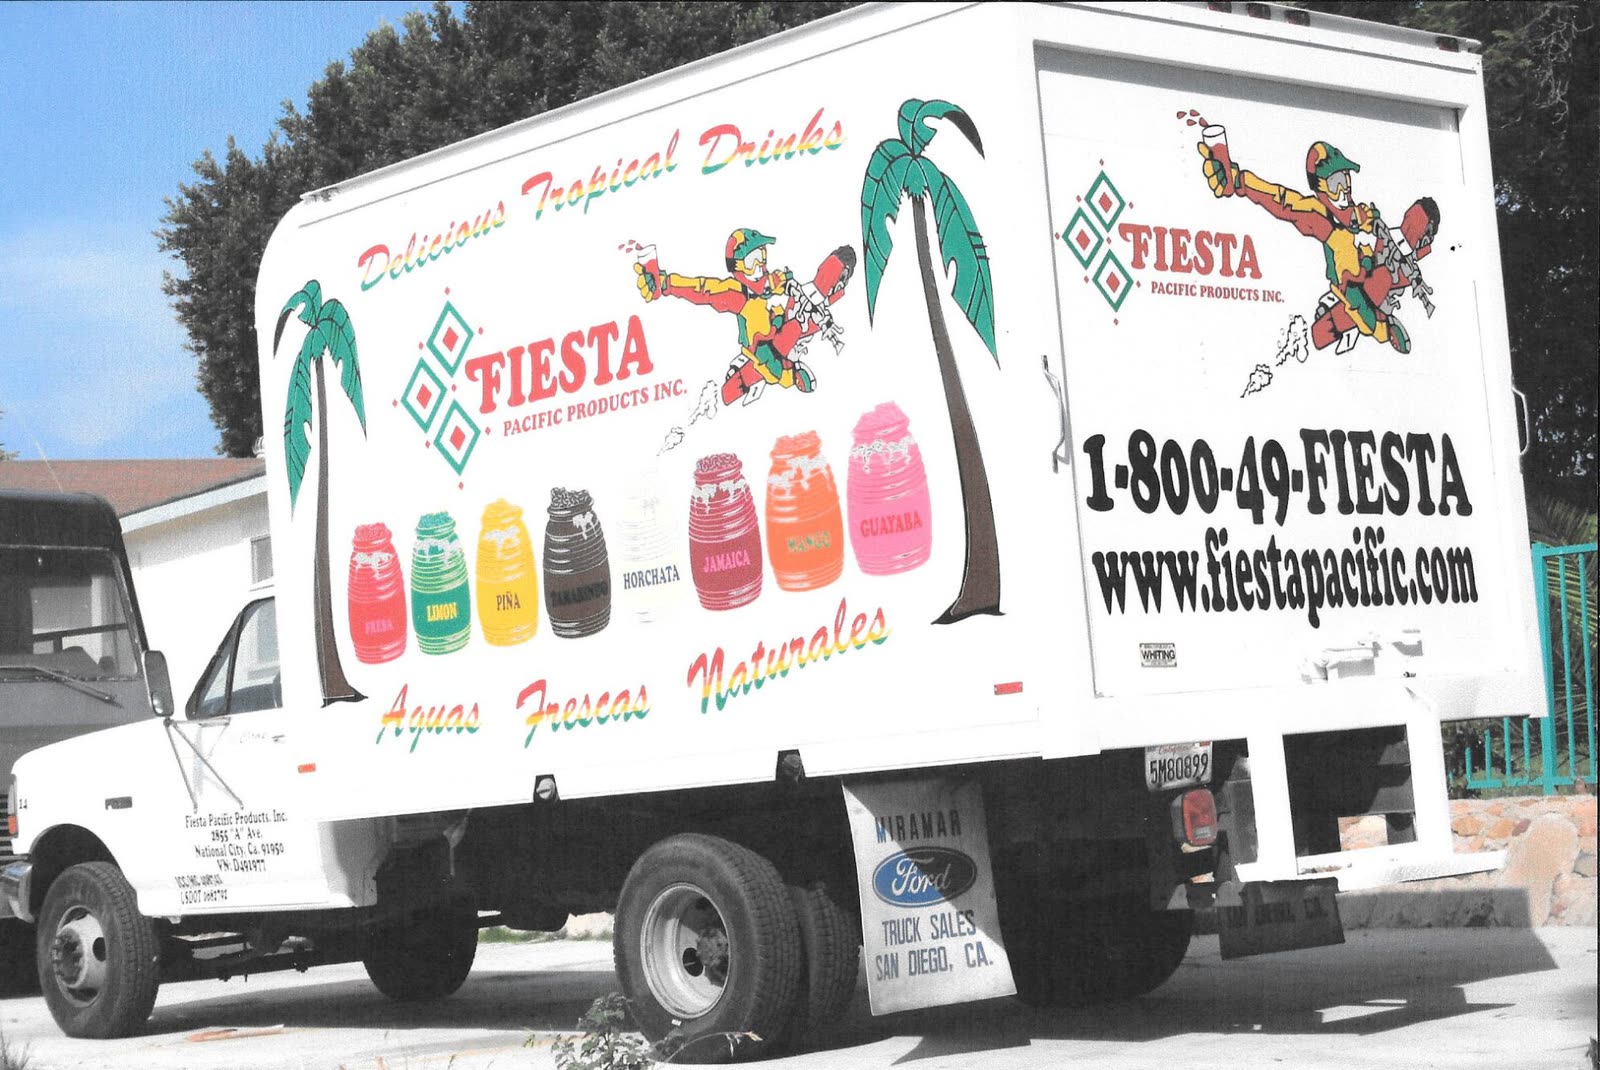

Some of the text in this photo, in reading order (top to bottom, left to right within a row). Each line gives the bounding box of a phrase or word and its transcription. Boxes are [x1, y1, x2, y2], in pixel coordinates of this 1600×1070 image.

[357, 107, 846, 292] Delicious Tropical Drinks
[1118, 223, 1263, 280] FIESTA
[1152, 281, 1284, 303] PACIFIC PRODUCTS INC.
[465, 315, 654, 414] FIESTA
[503, 379, 687, 436] PACIFIC PRODUCTS INC.
[1083, 428, 1473, 527] 1-800-49-FIESTA
[860, 511, 922, 538] GUAYABA
[786, 531, 831, 552] MANGO
[704, 550, 750, 572] JAMAICA
[623, 565, 680, 589] HORCHATA
[1092, 526, 1479, 629] www.fiestapacific.com
[426, 602, 457, 622] LIMON
[496, 590, 520, 611] PIÑA
[1141, 650, 1175, 660] WHITING
[375, 596, 888, 754] Aguas Frescas Naturales
[1150, 753, 1208, 784] 5M80899
[186, 816, 206, 828] Fiesta
[273, 809, 288, 822] Inc.
[247, 827, 262, 839] Ave.
[875, 809, 962, 844] MIRAMAR
[195, 845, 226, 857] National
[891, 857, 952, 896] Ford
[882, 909, 977, 946] TRUCK SALES
[876, 941, 994, 982] SAN DIEGO, CA.
